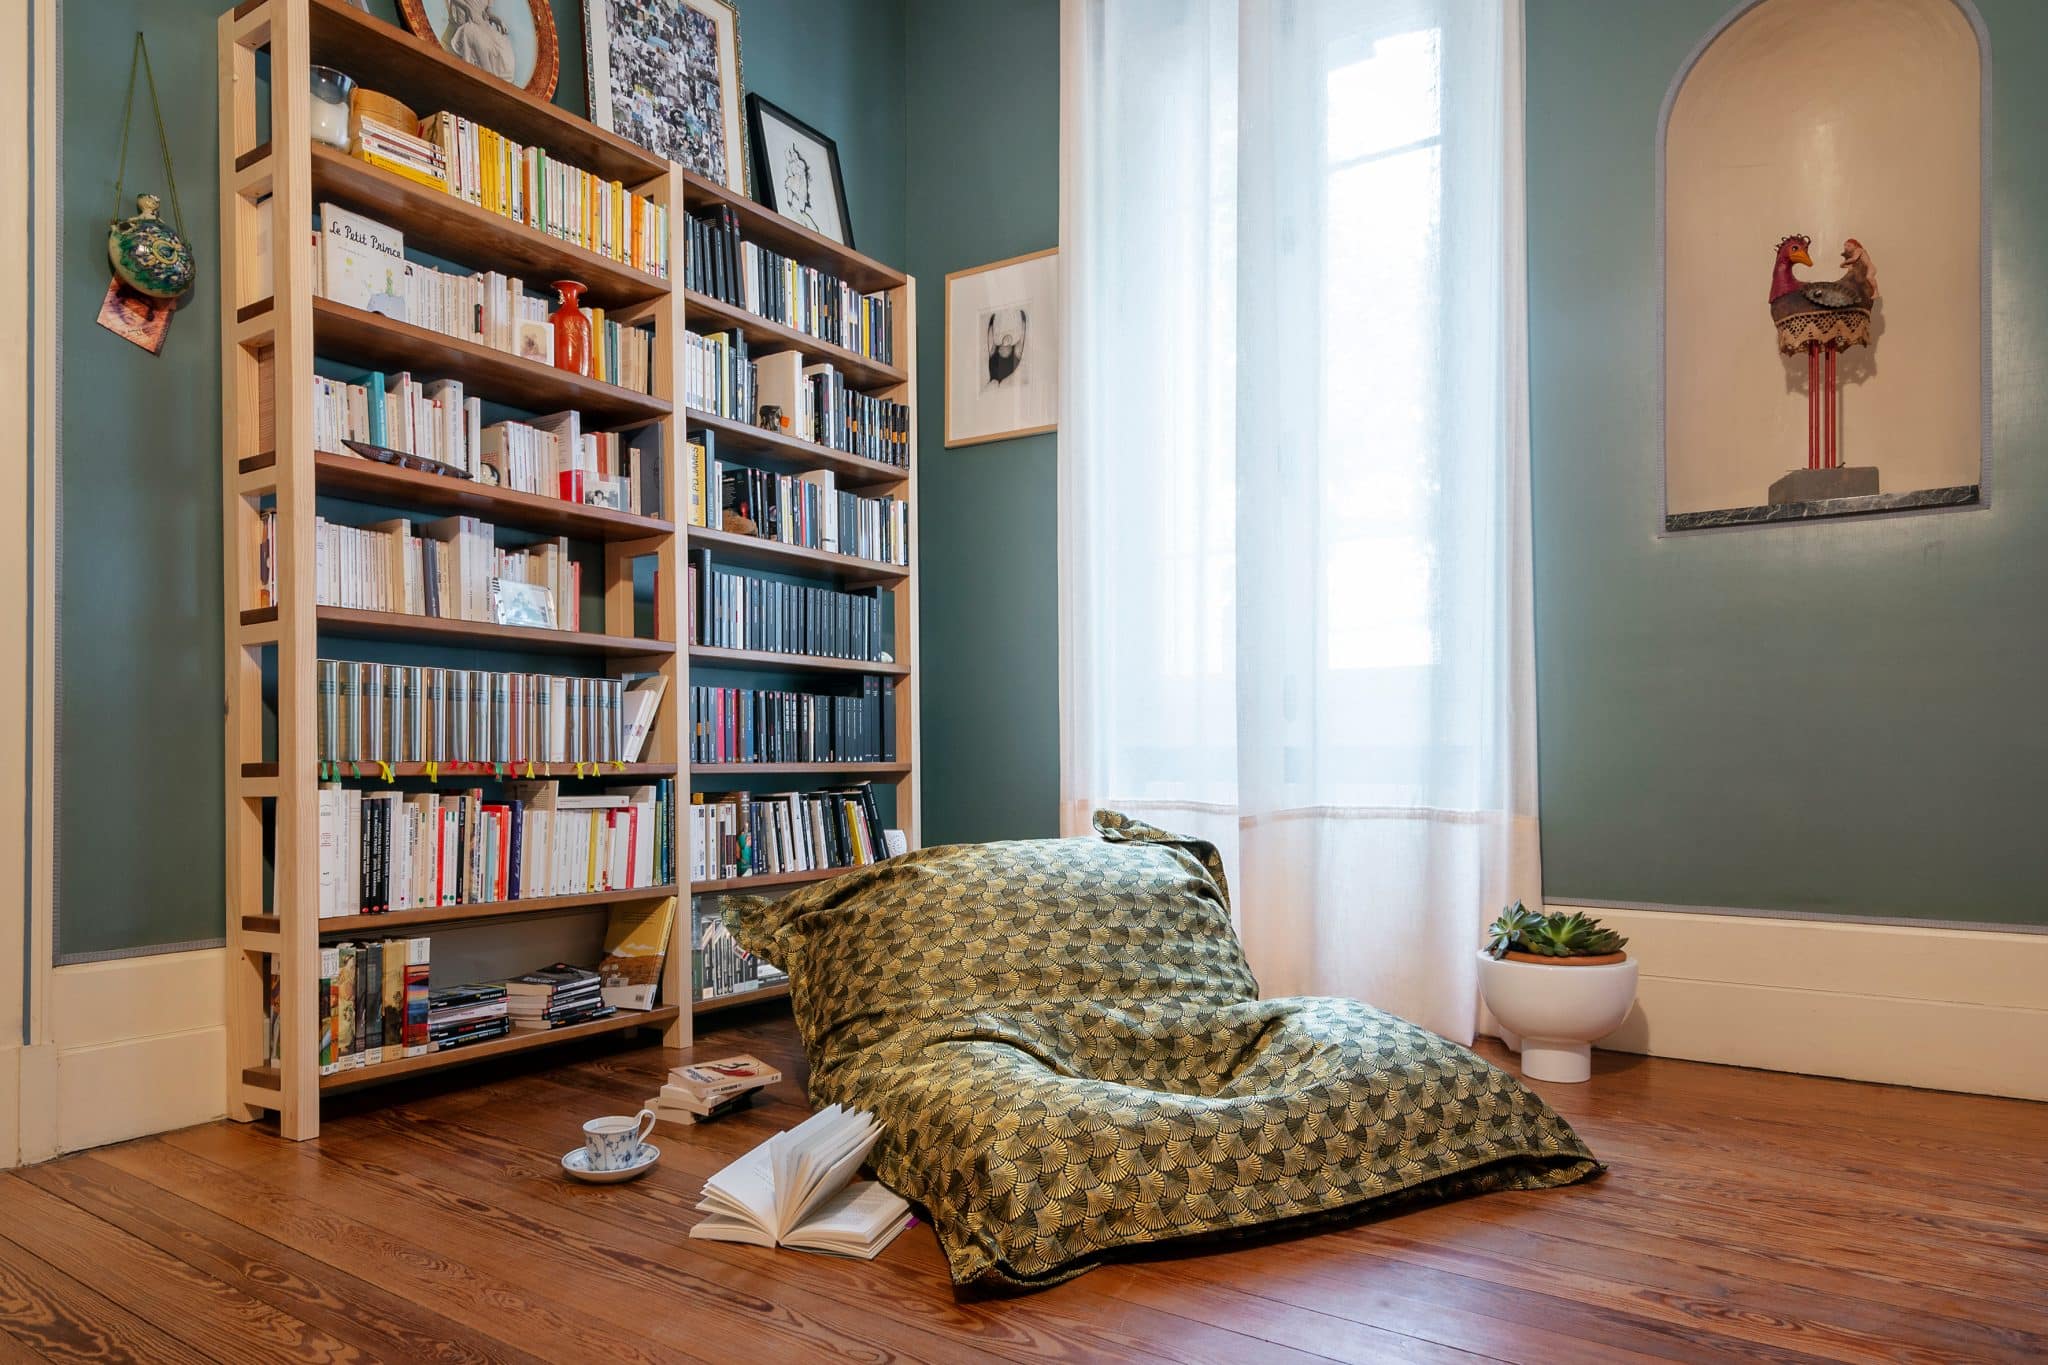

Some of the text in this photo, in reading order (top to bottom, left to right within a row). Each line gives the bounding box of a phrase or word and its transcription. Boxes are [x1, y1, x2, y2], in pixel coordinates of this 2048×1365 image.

[330, 221, 342, 236] Le
[344, 226, 368, 246] Petit
[370, 235, 402, 259] Prince
